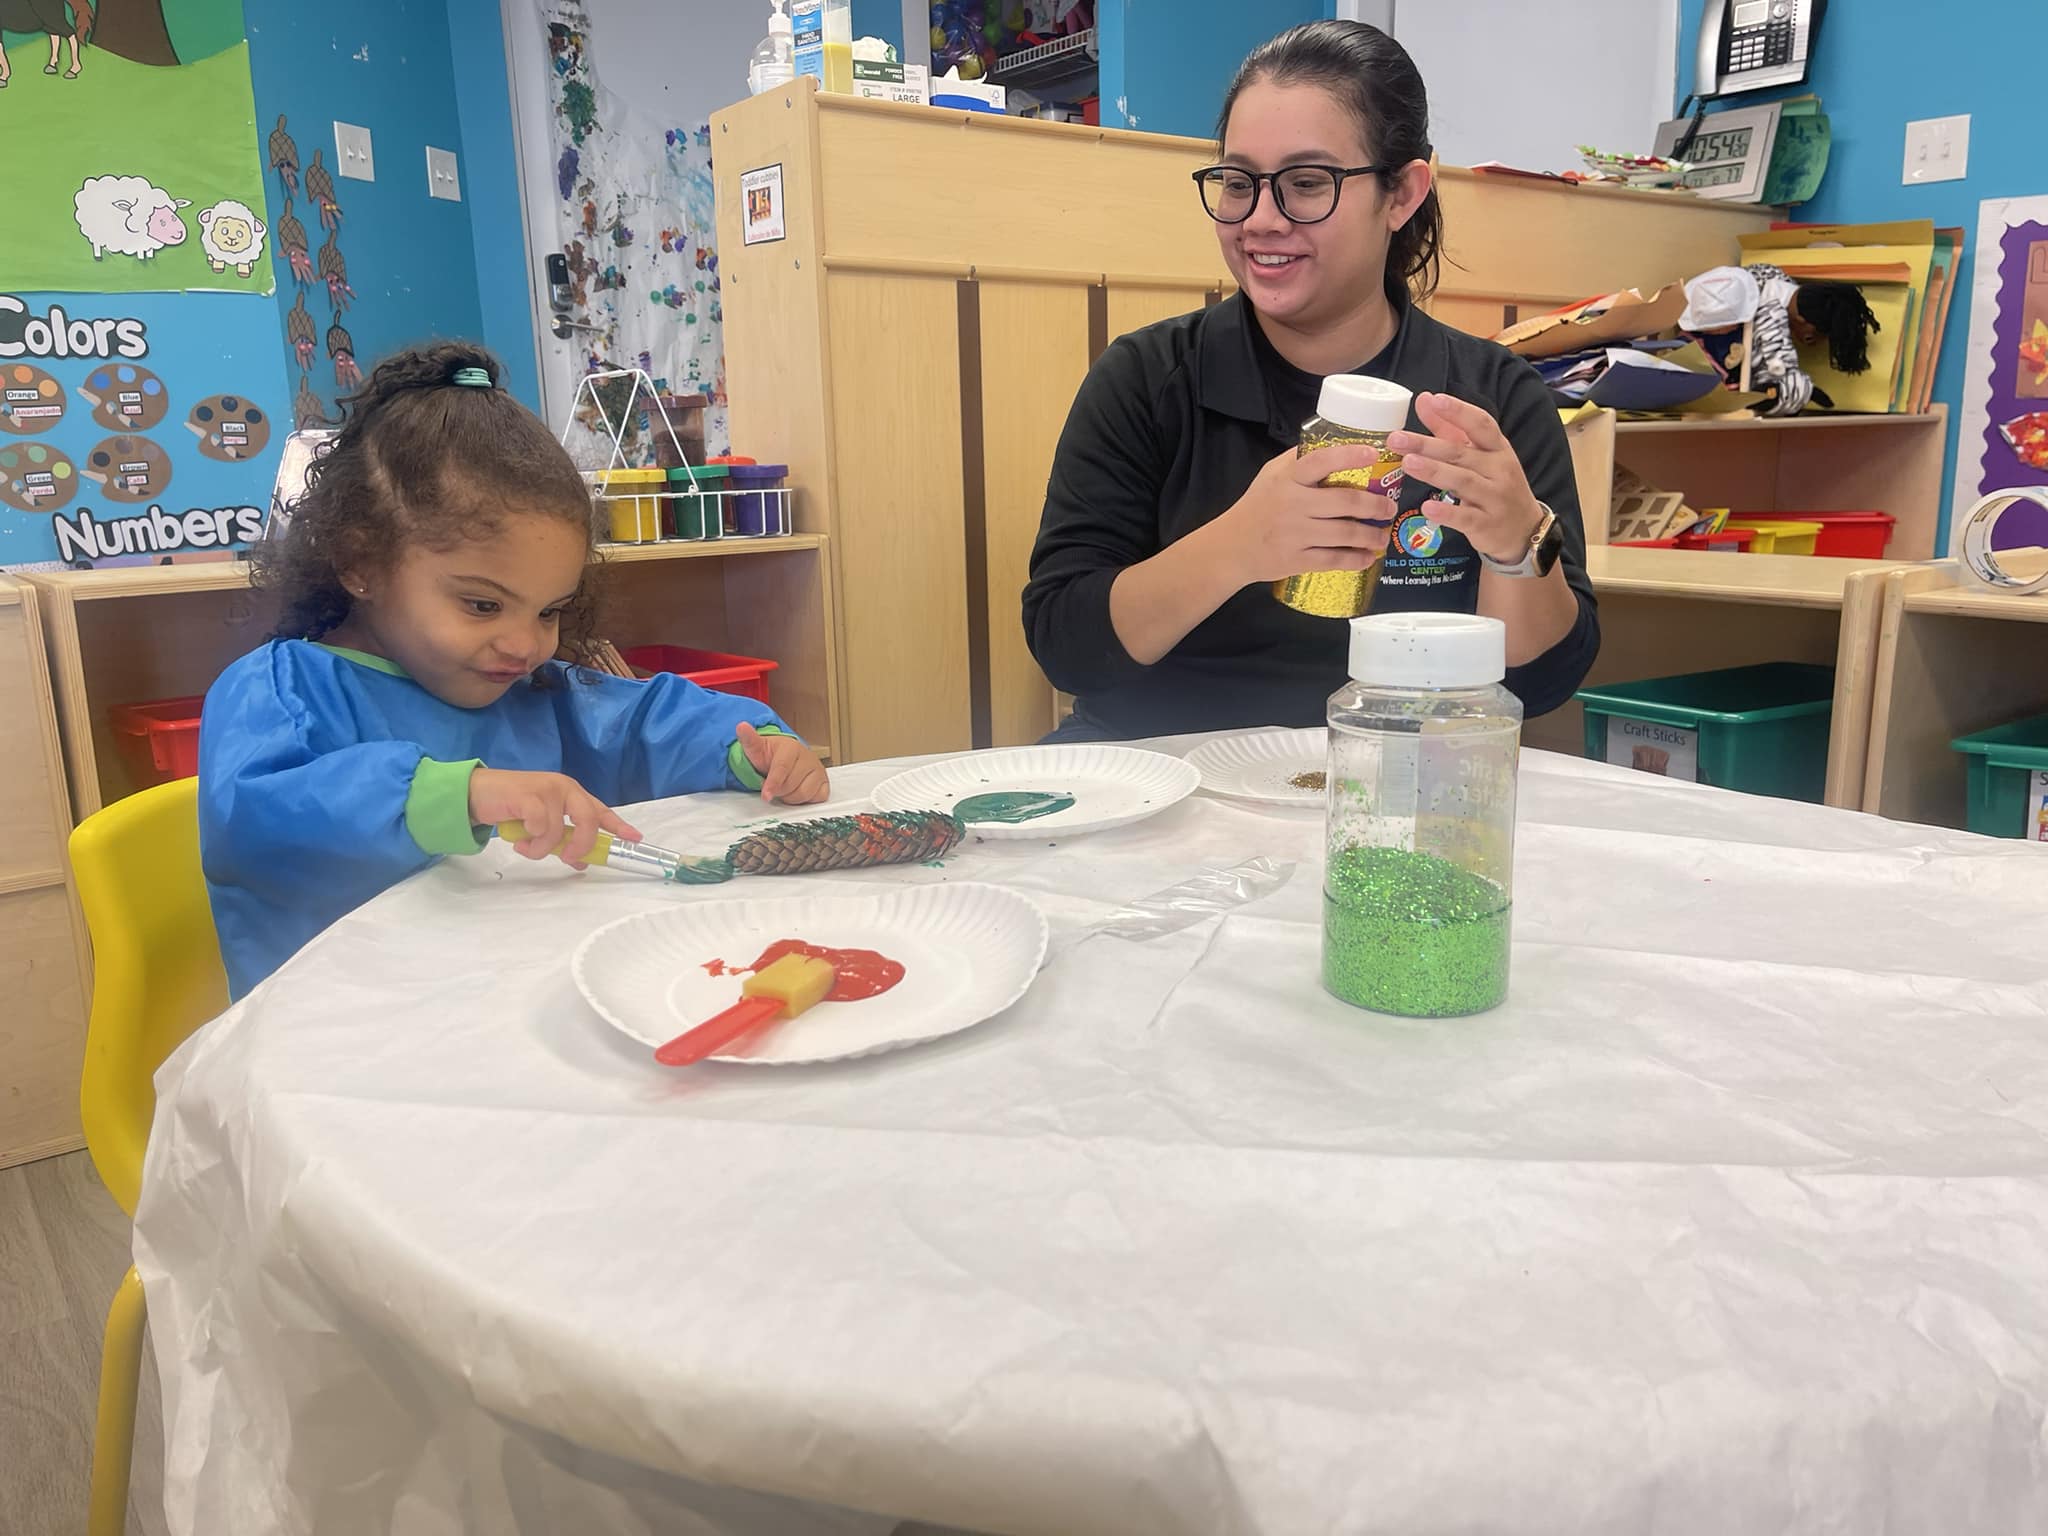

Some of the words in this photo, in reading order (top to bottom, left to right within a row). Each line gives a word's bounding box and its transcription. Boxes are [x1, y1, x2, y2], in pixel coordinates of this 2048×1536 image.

[892, 94, 920, 104] LARGE
[0, 297, 148, 358] Colors
[7, 391, 36, 400] Orange
[15, 406, 61, 416] Anaranjado
[122, 463, 148, 471] Brown
[54, 505, 264, 563] Numbers
[1385, 559, 1406, 567] HILD
[1410, 566, 1445, 575] CENTER
[1405, 575, 1431, 587] Learning
[1432, 575, 1441, 584] Has
[1623, 722, 1650, 738] Craft
[1653, 728, 1686, 746] Sticks
